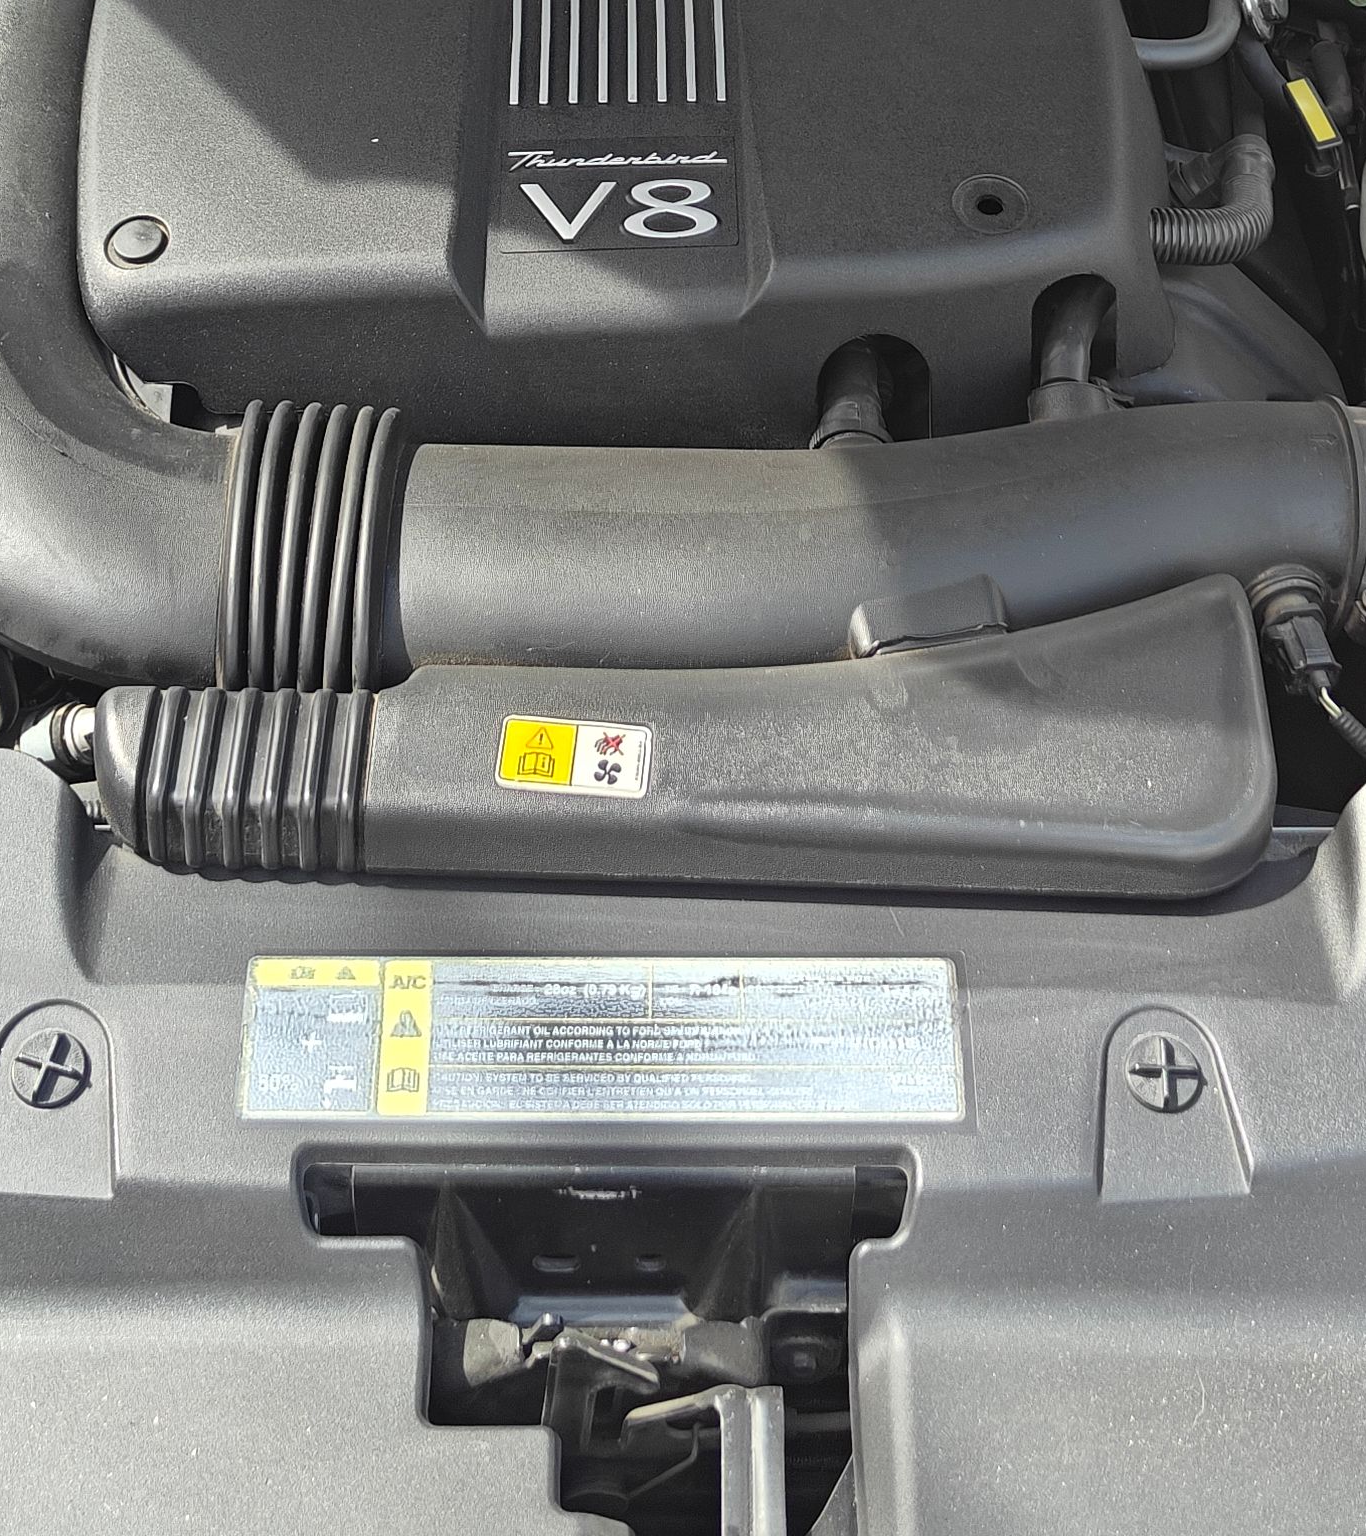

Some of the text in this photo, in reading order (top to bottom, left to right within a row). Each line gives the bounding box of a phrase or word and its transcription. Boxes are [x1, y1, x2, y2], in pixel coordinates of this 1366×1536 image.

[507, 149, 728, 173] Thunderbird
[519, 178, 718, 243] V8
[389, 974, 427, 990] A/C
[533, 1025, 551, 1036] OIL
[552, 1025, 613, 1036] ACCORDING
[616, 1026, 630, 1036] TO
[483, 1039, 543, 1049] LUBRIFIANT
[546, 1039, 603, 1049] CONFORME
[616, 1039, 630, 1049] LA
[458, 1052, 494, 1063] ACEITE
[497, 1052, 525, 1063] PARA
[527, 1052, 613, 1063] REFRIGERANTES
[615, 1053, 675, 1063] CONFORME
[531, 1073, 545, 1083] TO
[617, 1073, 631, 1083] BY
